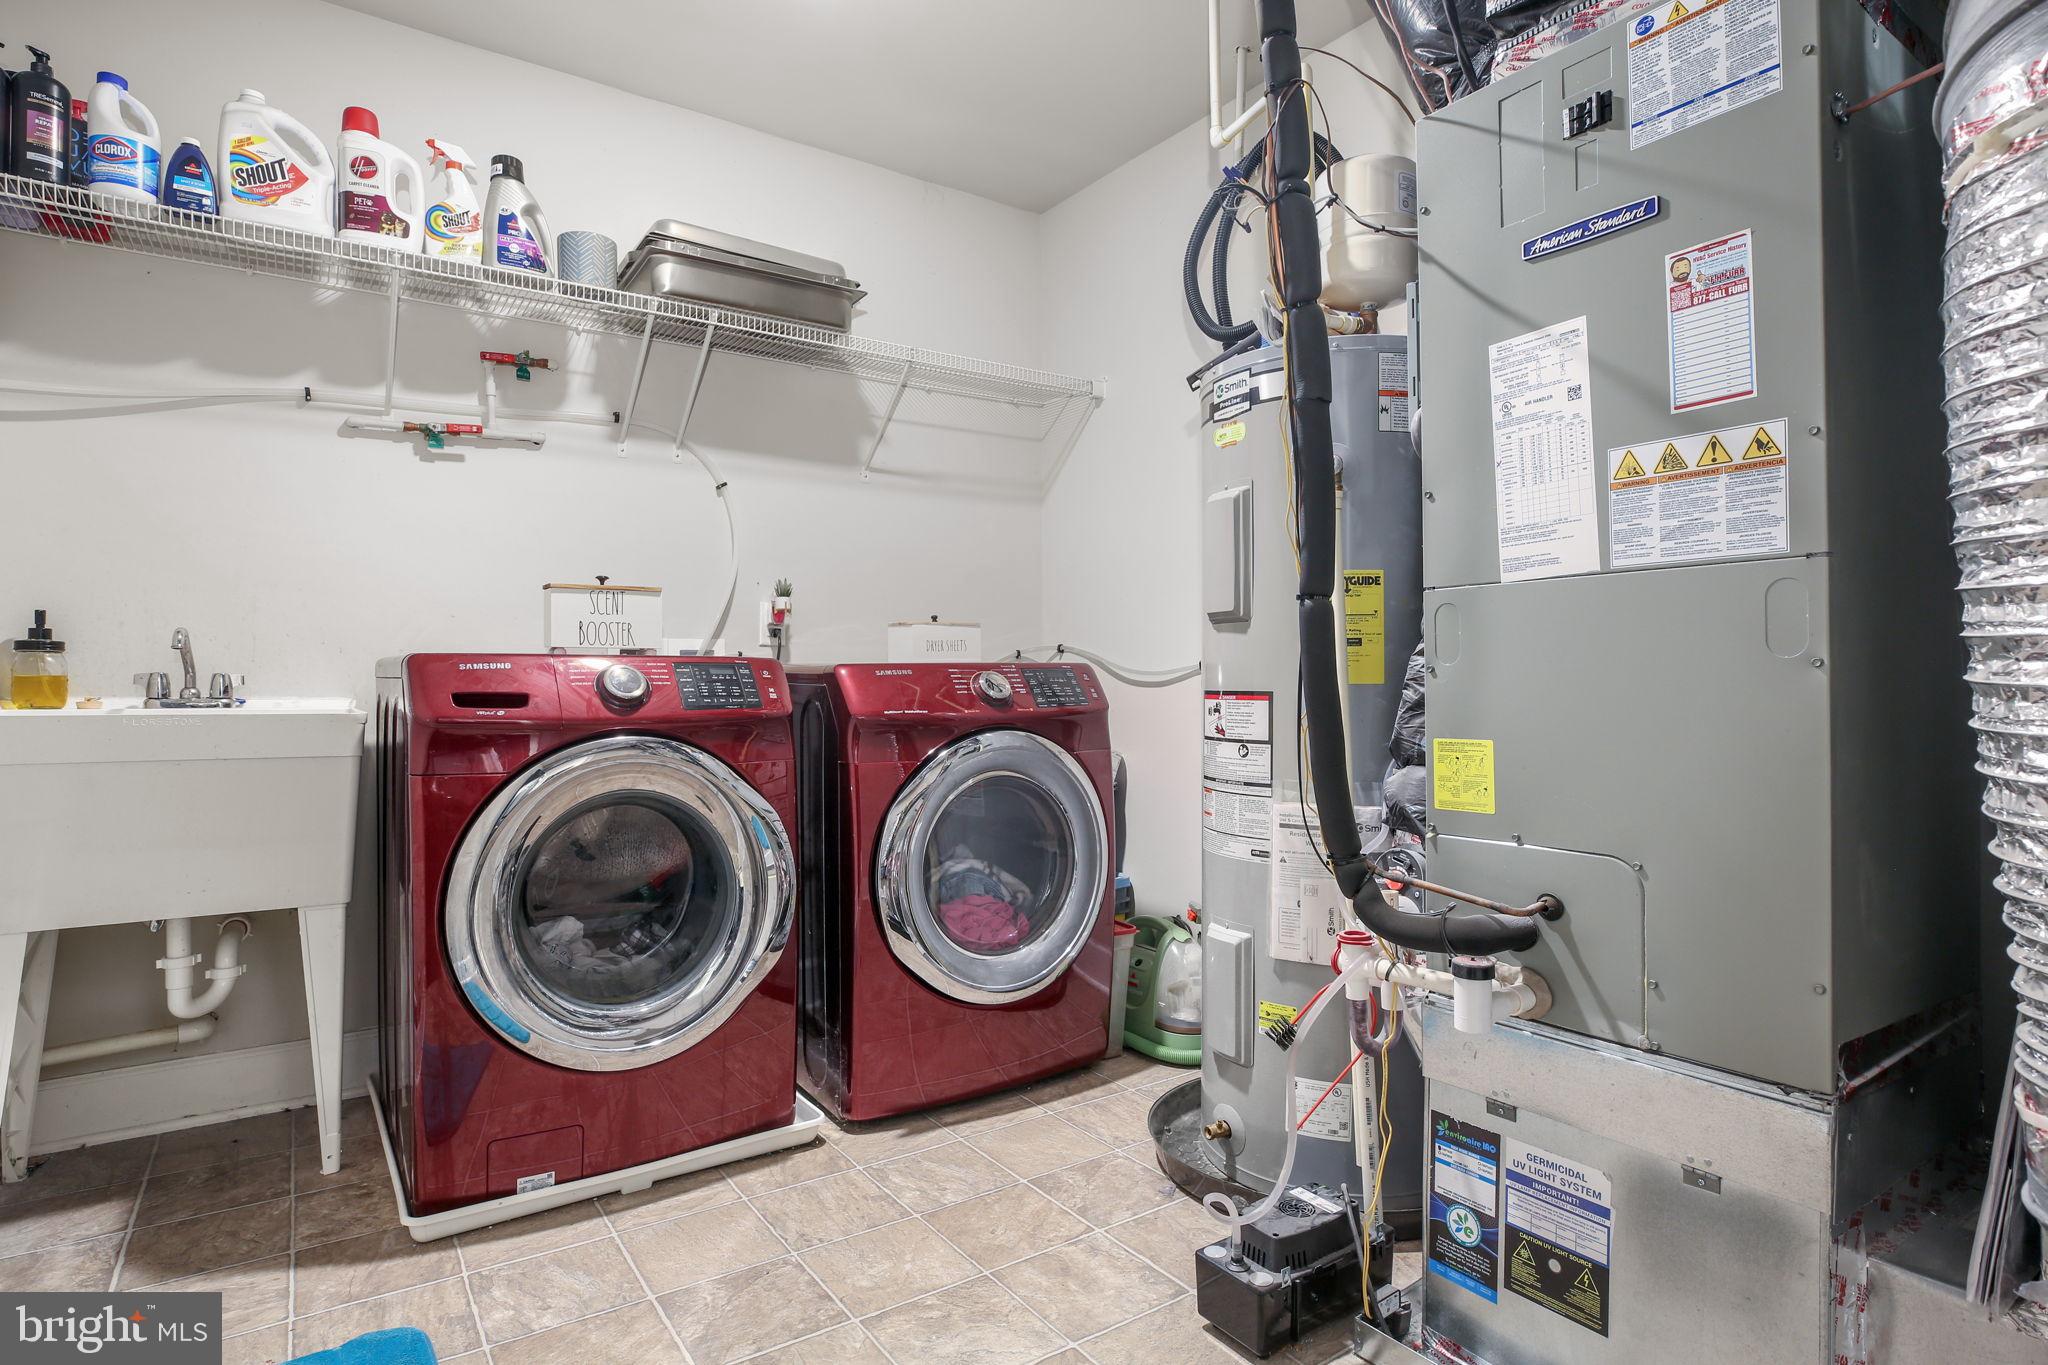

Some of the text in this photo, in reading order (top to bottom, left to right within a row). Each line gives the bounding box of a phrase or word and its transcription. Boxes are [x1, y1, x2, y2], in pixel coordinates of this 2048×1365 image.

[95, 143, 132, 158] CLOROX
[235, 158, 286, 186] SHOUT
[442, 210, 470, 228] SHOUT
[1530, 202, 1648, 255] American Standard
[1693, 283, 1748, 305] 877-CALL FURR
[1224, 378, 1247, 393] Smith
[1667, 468, 1720, 480] AVERTISSEMENT
[1734, 459, 1784, 471] ADVERTENCIA
[1622, 480, 1650, 488] WARNING
[1344, 576, 1381, 586] YGUIDE
[590, 590, 626, 615] SCENT
[579, 620, 636, 647] BOOSTER
[926, 640, 967, 652] DRYER SHEETS
[1445, 1130, 1482, 1148] enviroaire
[1526, 1153, 1588, 1183] GERMICIDAL
[1512, 1159, 1602, 1201] UV LIGHT SYSTEM
[1532, 1182, 1580, 1206] IMPORTANT!
[1532, 1190, 1568, 1209] REPLACEMENT
[1569, 1204, 1606, 1224] INFORMATION
[1520, 1232, 1542, 1247] CAUTION
[1552, 1247, 1568, 1258] LIGHT
[1569, 1254, 1592, 1268] SOURCE
